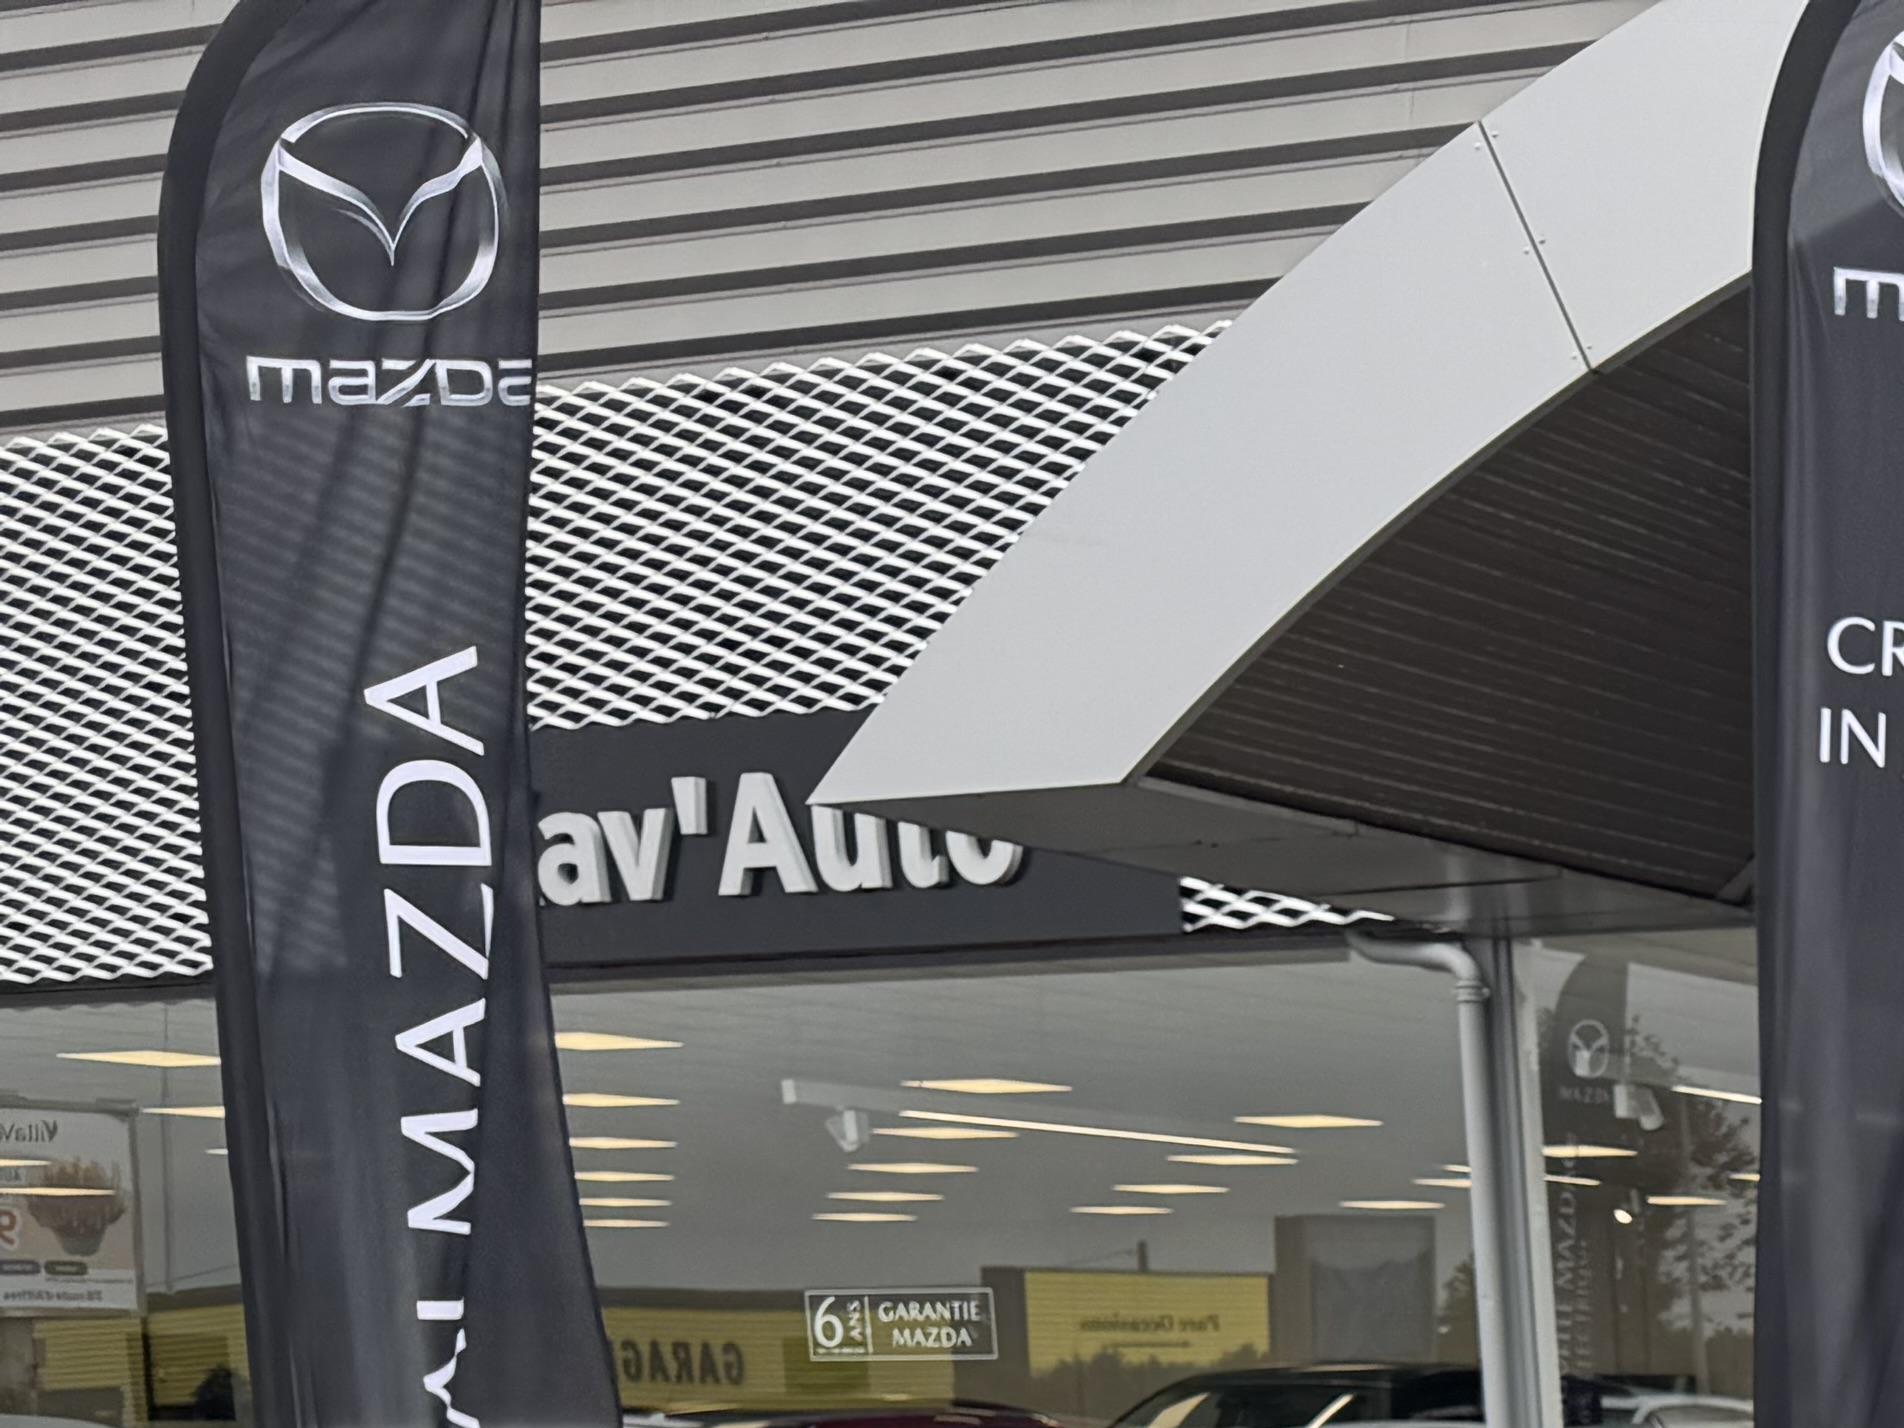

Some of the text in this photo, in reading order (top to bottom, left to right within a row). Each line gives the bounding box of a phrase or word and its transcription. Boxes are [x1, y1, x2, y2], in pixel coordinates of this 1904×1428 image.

[1818, 706, 1888, 768] IN
[537, 772, 1023, 907] av'Auto
[363, 645, 495, 1236] MAZDA
[814, 1296, 864, 1348] 6 ANS
[877, 1301, 981, 1322] GARANTIE
[892, 1327, 973, 1348] MAZDA
